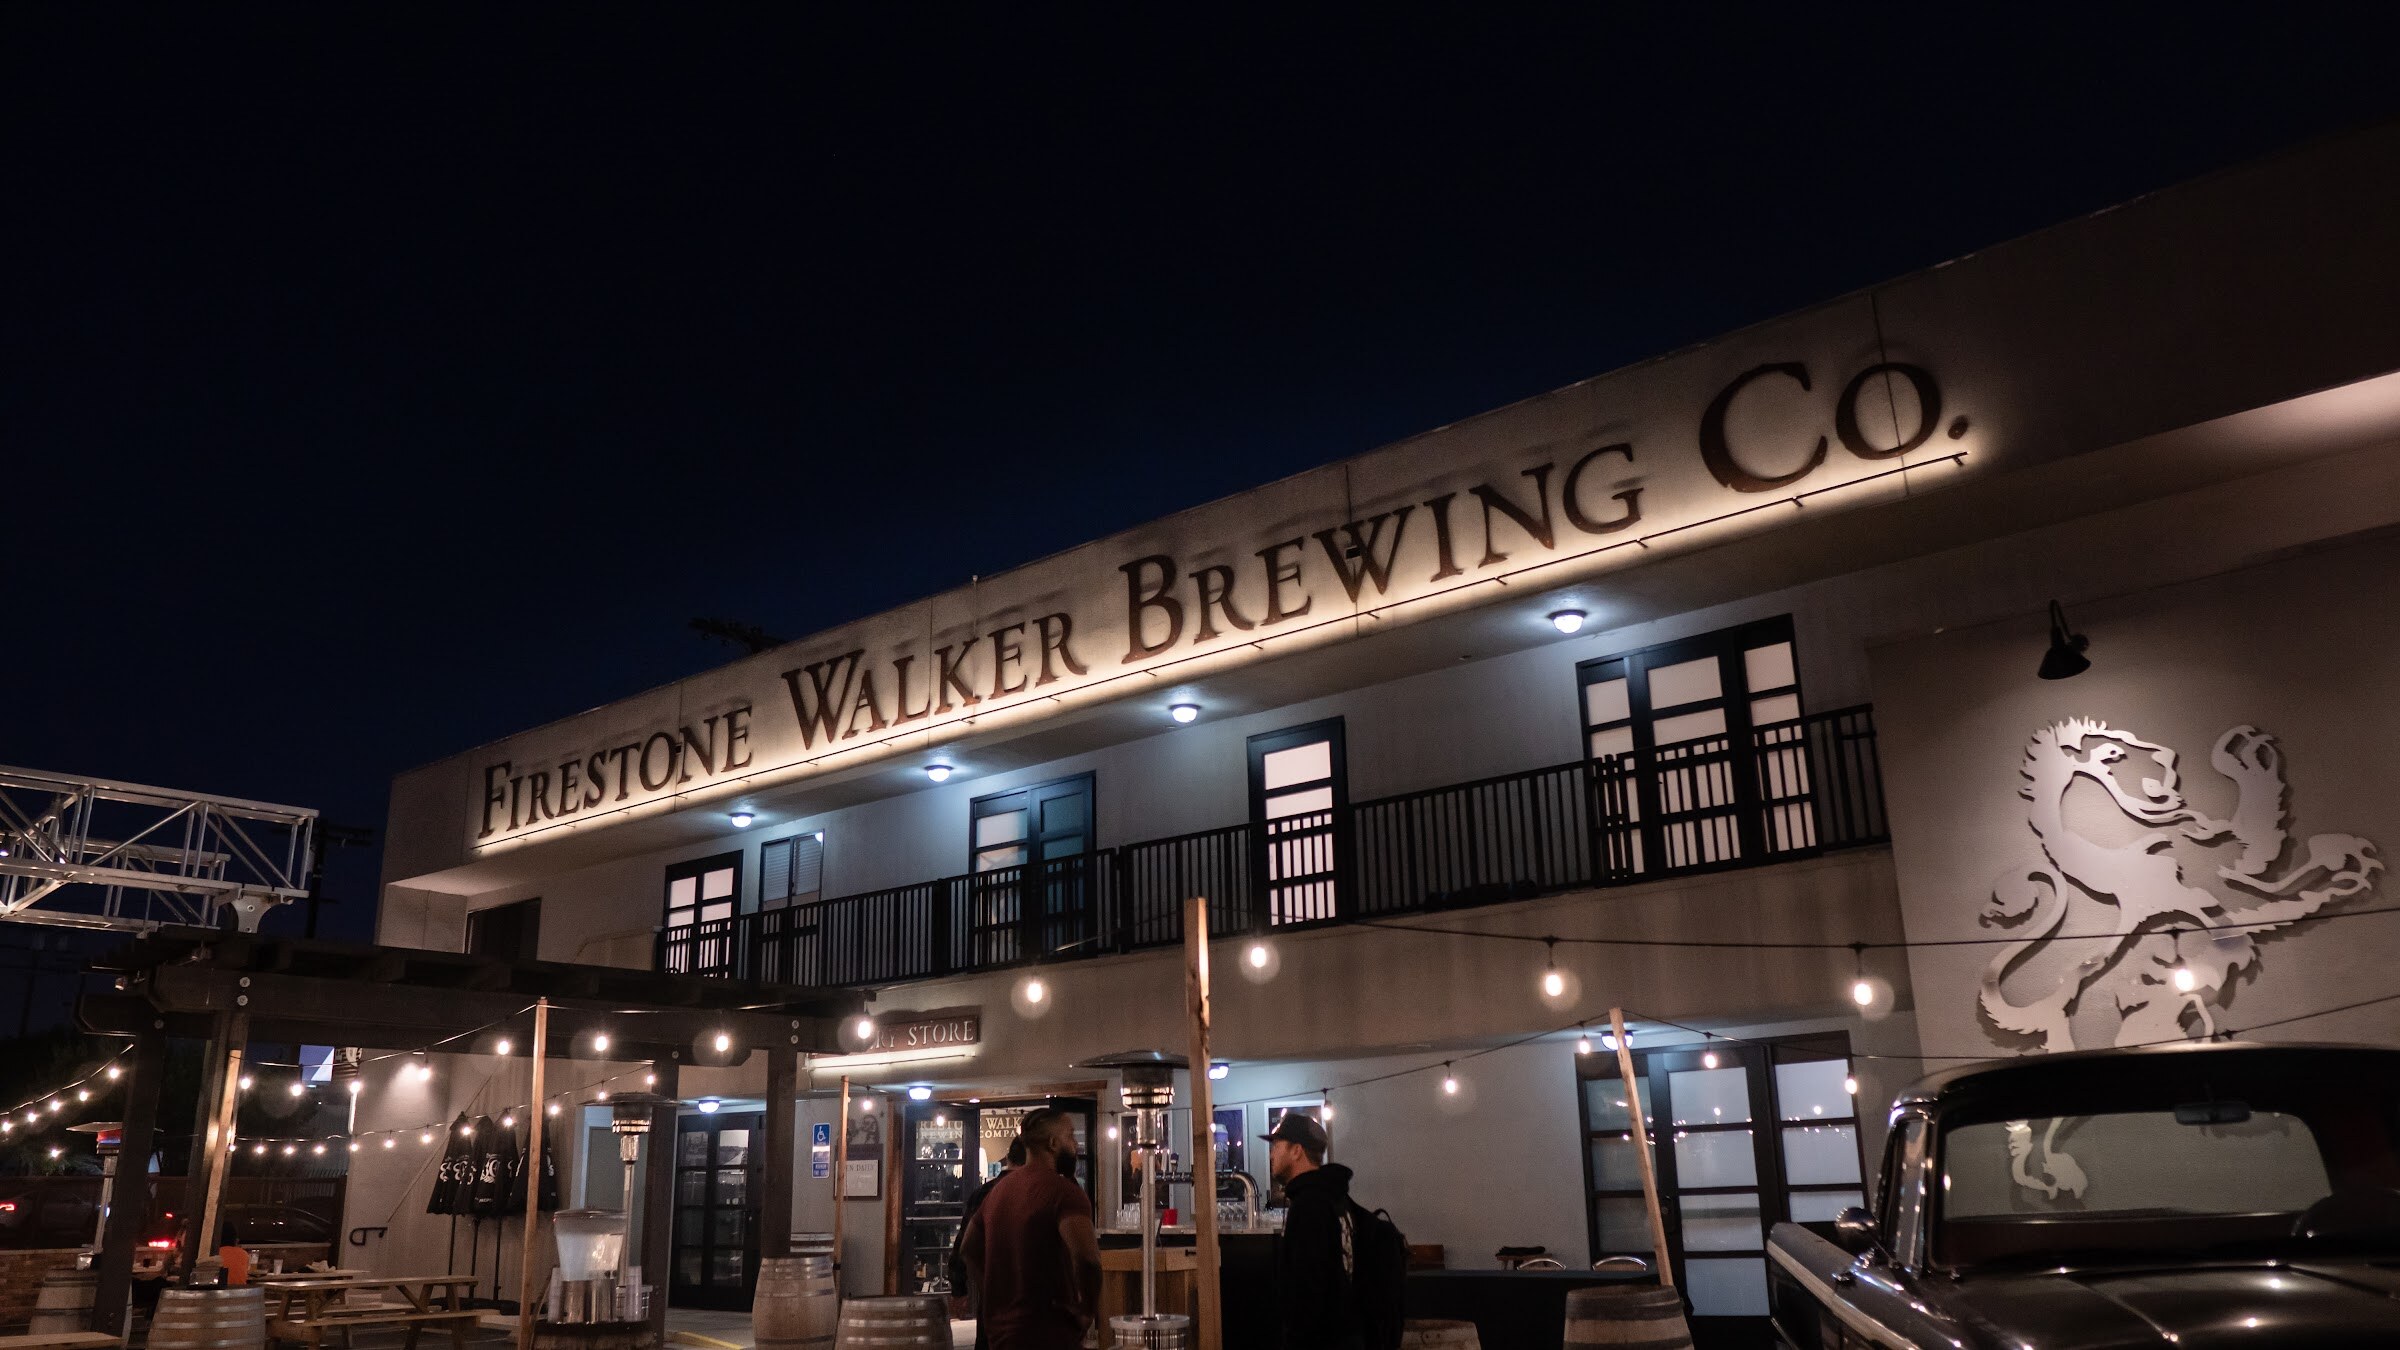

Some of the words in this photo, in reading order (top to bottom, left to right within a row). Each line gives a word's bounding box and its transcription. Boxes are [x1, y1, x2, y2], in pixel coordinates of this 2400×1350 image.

[478, 705, 753, 839] FIRESTONE
[781, 612, 1087, 750] WALKER
[1118, 443, 1644, 663] BREWING
[907, 1020, 974, 1046] STORE
[986, 1116, 1022, 1130] WALK
[980, 1129, 1017, 1139] COMPA
